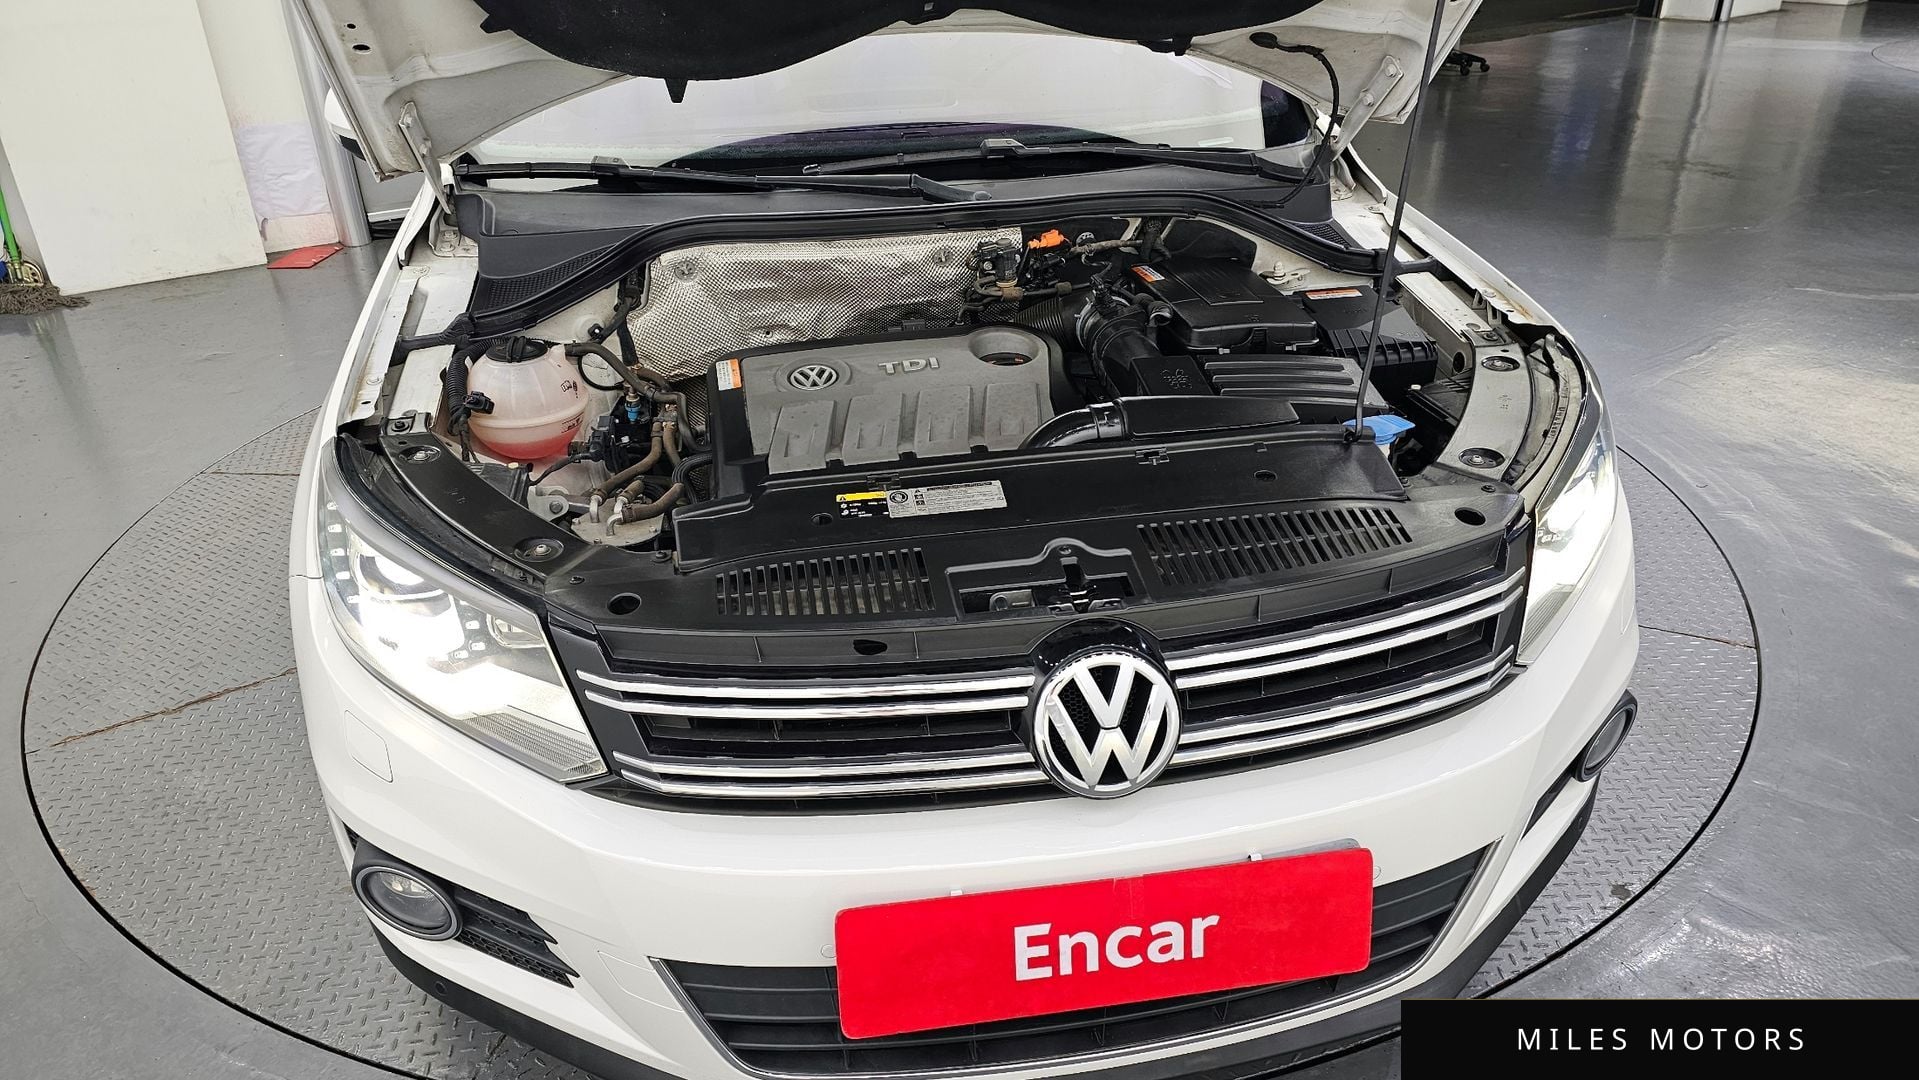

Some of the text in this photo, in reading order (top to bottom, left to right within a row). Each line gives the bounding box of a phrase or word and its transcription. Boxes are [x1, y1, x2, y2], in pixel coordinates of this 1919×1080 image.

[790, 365, 838, 391] VW
[878, 357, 941, 375] TDI
[1037, 654, 1178, 796] VW
[1013, 914, 1220, 982] Encar
